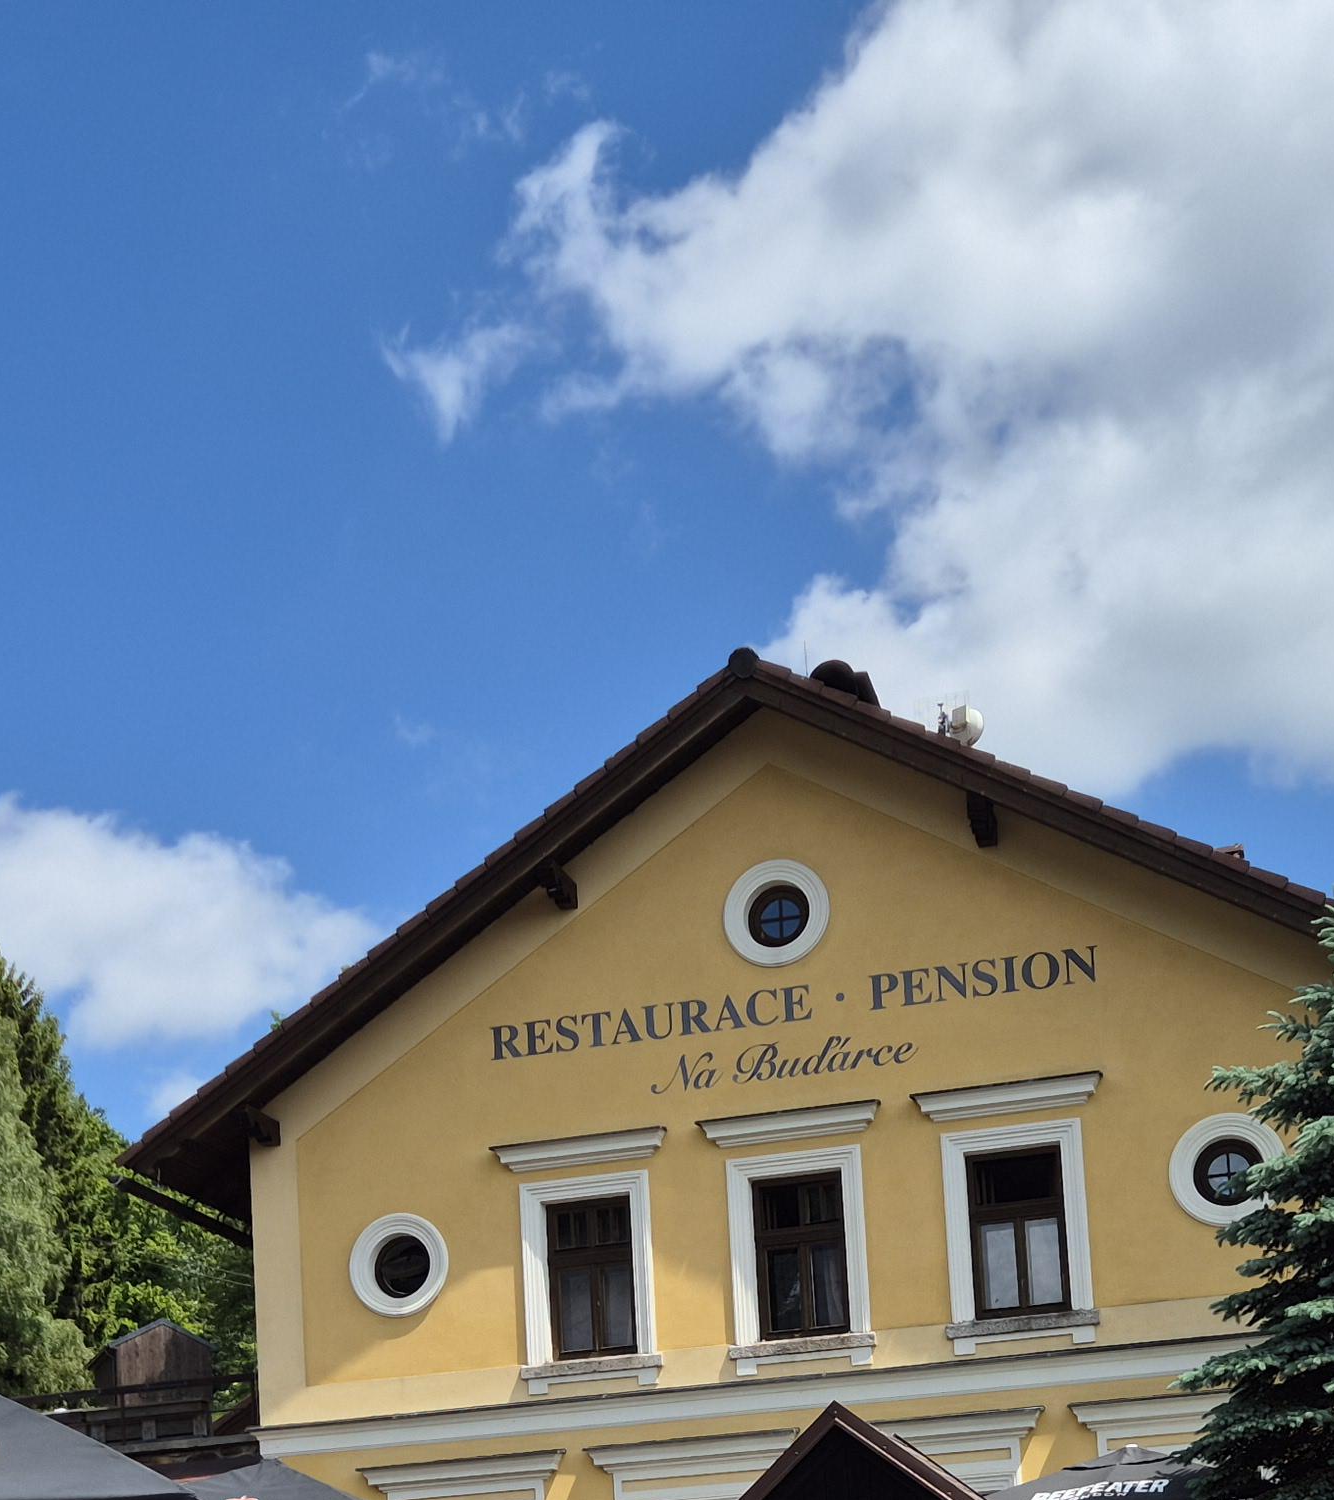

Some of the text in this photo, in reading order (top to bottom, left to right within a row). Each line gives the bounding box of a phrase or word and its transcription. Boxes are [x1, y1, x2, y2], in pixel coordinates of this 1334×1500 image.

[490, 945, 1098, 1061] RESTAURACE PENSION
[651, 1051, 723, 1095] Na
